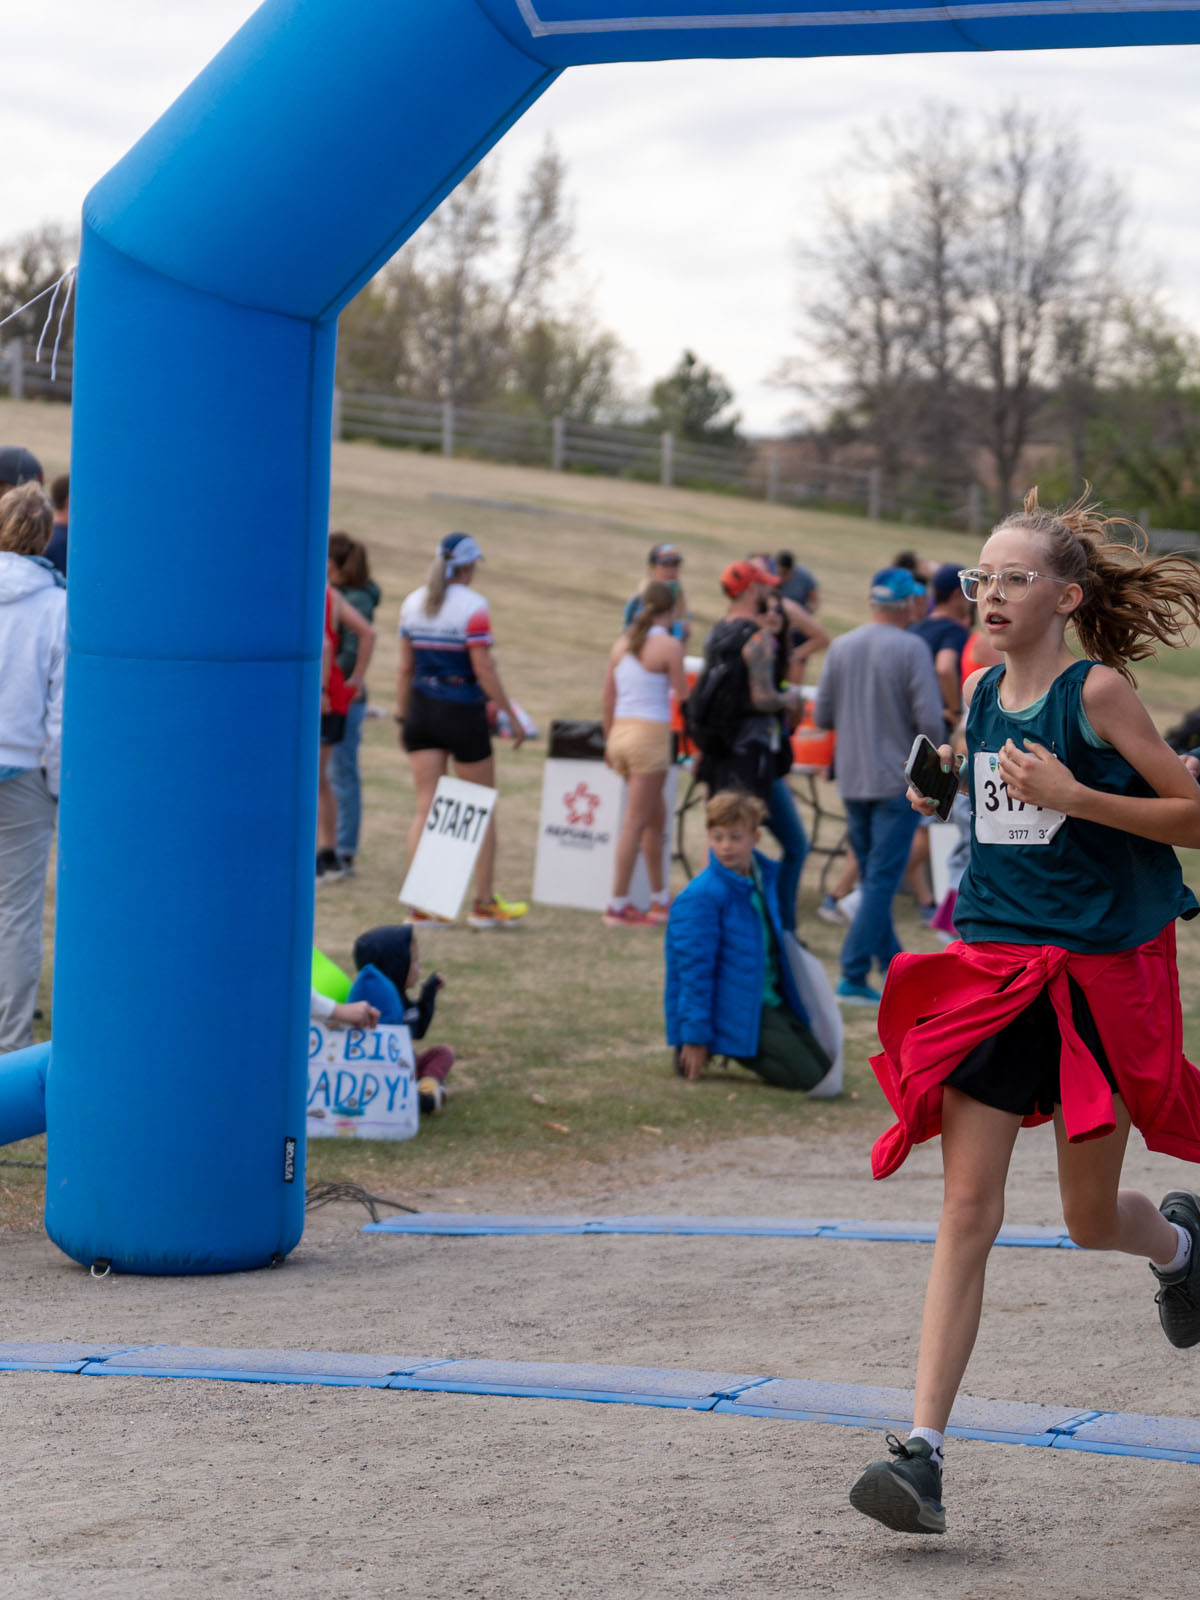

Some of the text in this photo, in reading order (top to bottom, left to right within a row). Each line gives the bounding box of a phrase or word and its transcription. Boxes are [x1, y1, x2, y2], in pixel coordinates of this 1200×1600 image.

[984, 780, 1043, 812] 31
[427, 796, 488, 844] START
[1008, 829, 1049, 840] 3177 3
[344, 1027, 400, 1062] BIG
[306, 1070, 407, 1112] ADDY!
[285, 1142, 295, 1180] VEVOR
